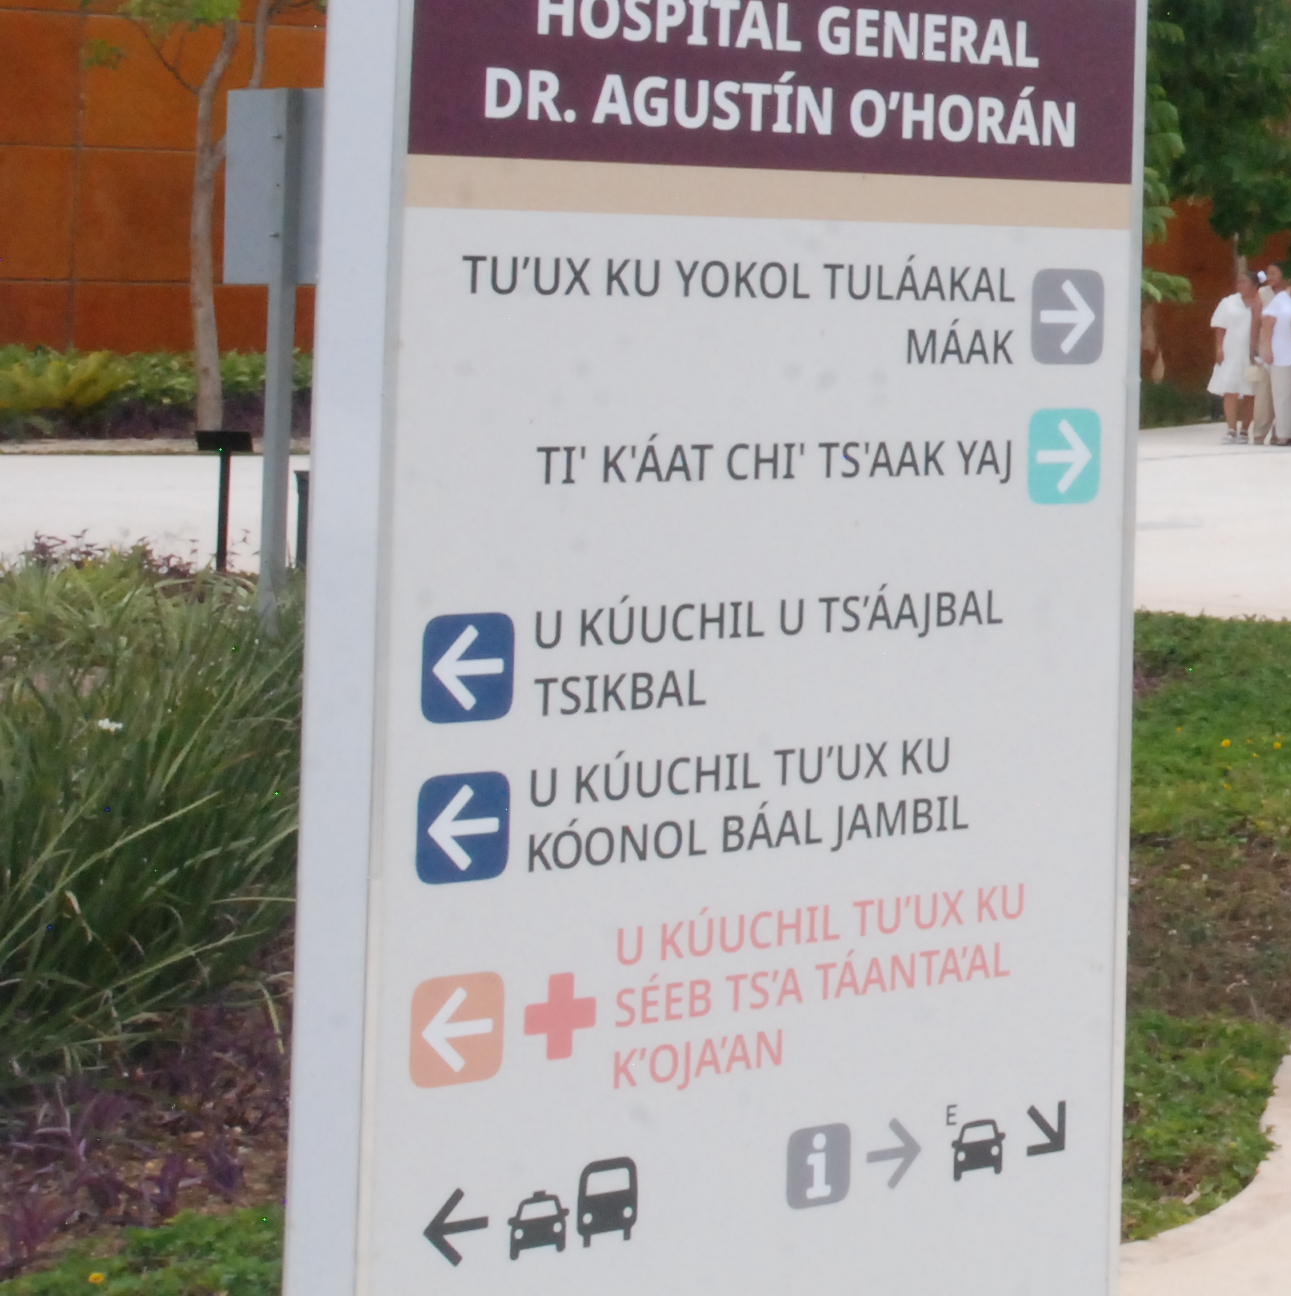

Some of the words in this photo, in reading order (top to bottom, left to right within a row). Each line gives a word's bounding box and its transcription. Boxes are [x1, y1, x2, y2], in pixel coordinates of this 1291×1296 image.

[818, 5, 1039, 68] GENERAL
[484, 66, 576, 124] DR.
[592, 71, 833, 136] AGUSTÍN
[850, 86, 1076, 148] O'HORÁN
[463, 255, 590, 297] TU'UX
[607, 259, 660, 298] KU
[676, 260, 809, 300] YOKOL
[824, 255, 1015, 302] TULÁAKAL
[906, 317, 1013, 364] MÁAK
[537, 444, 587, 485] TI'
[603, 434, 713, 483] K'ÁAT
[727, 442, 806, 480] CHI'
[819, 441, 944, 478] TS'AAK
[957, 439, 1013, 484] YAJ
[535, 610, 563, 649] U
[581, 593, 765, 647] KÚUCHIL
[780, 598, 805, 636] U
[819, 584, 1003, 639] TS'ÁAJBAL
[535, 669, 706, 716] TSIKBAL
[530, 768, 557, 808] U
[576, 751, 760, 804] KÚUCHIL
[774, 742, 887, 787] TU'UX
[902, 737, 951, 775] KU
[528, 817, 708, 872] KÓONOL
[723, 807, 822, 853] BÁAL
[831, 794, 968, 852] JAMBIL
[616, 926, 644, 965] U
[661, 905, 840, 960] KÚUCHIL
[853, 890, 963, 936] TU'UX
[977, 883, 1025, 922] KU
[615, 970, 711, 1028] SÉEB
[726, 968, 804, 1012] TS'A
[815, 941, 1011, 1001] TÁANTA'AL
[613, 1029, 783, 1091] K'OJA'AN
